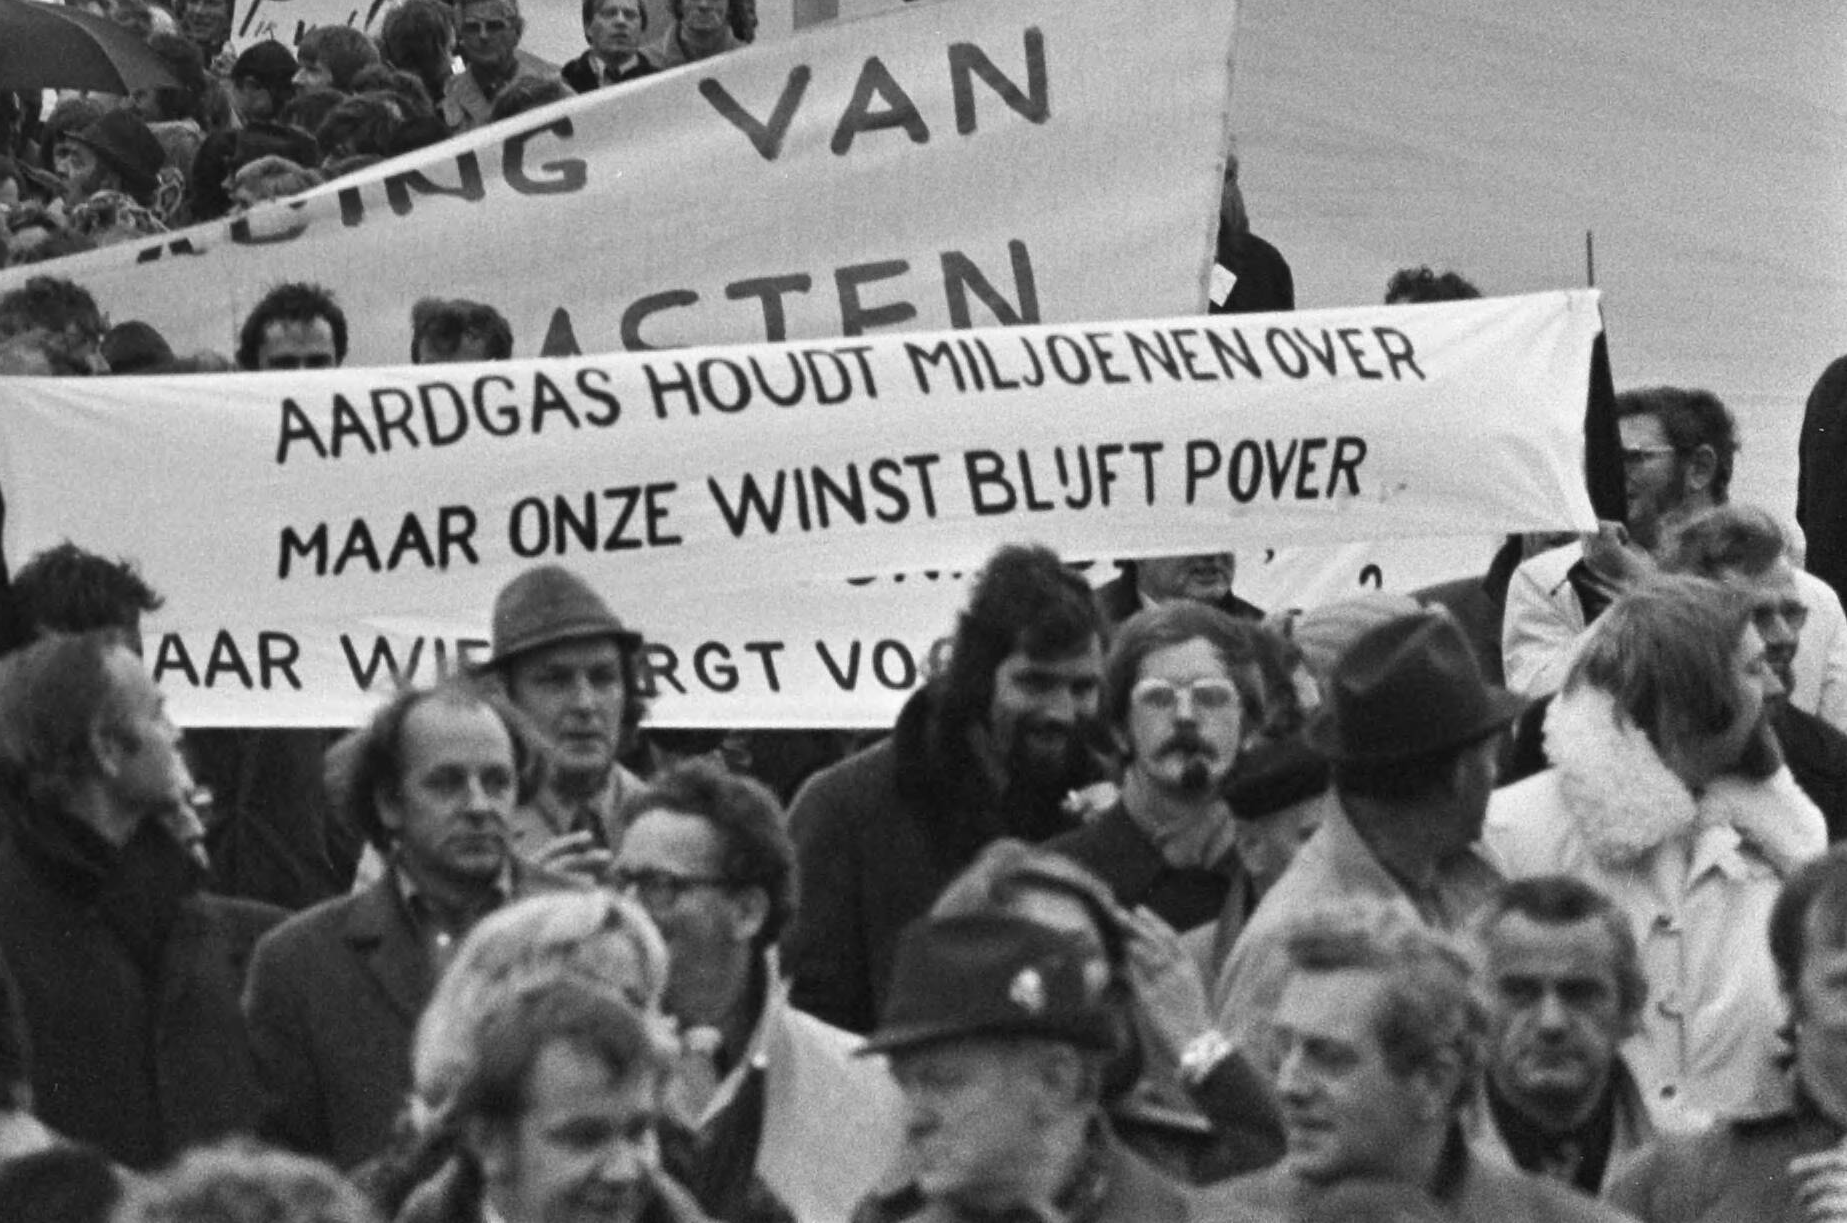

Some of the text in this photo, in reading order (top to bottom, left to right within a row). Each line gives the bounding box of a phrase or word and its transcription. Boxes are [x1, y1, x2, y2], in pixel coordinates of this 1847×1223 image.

[699, 25, 1051, 163] VAN
[276, 326, 1427, 465] AARDGAS HOUDT MILJOENEN OVER
[277, 503, 480, 580] MAAR
[508, 480, 683, 559] ONZE
[706, 452, 941, 538] WINST
[1185, 435, 1368, 506] POVER
[154, 629, 303, 691] AAR
